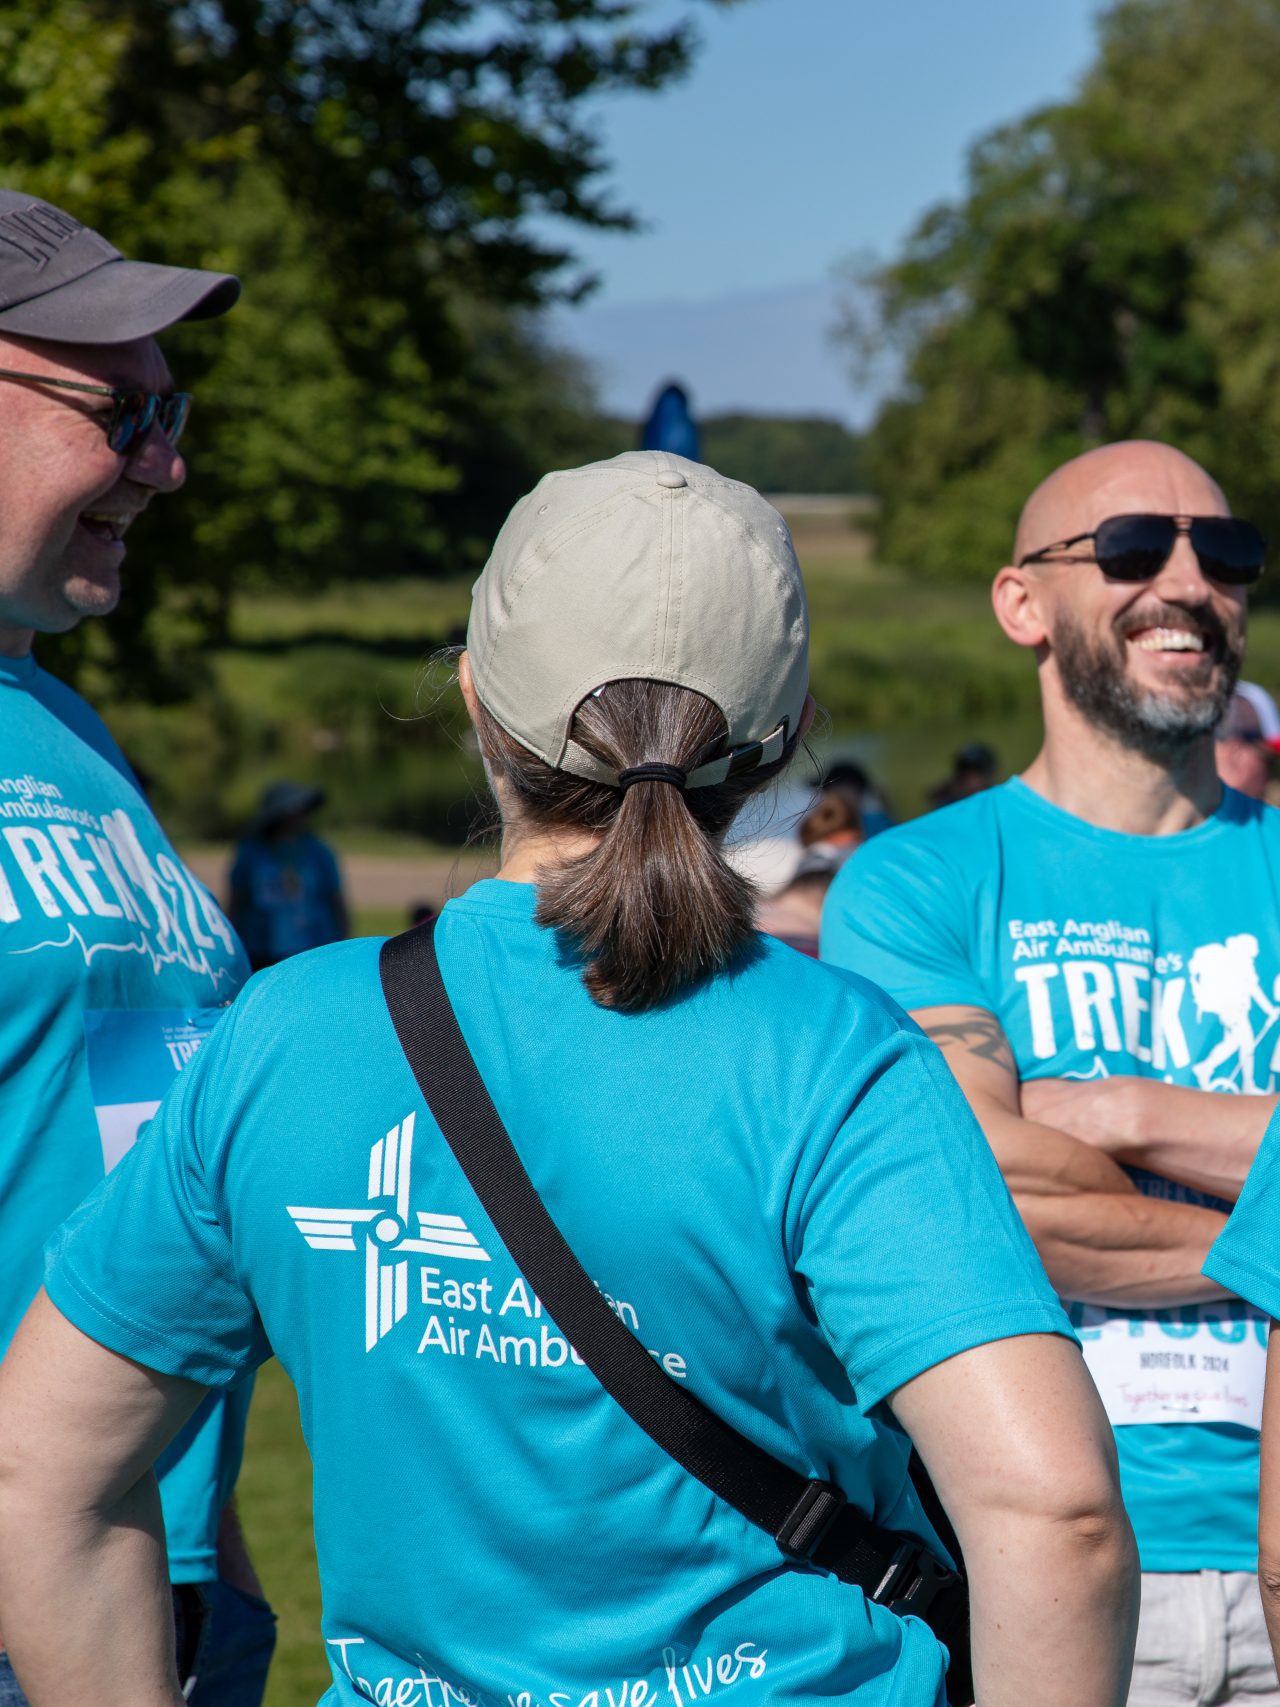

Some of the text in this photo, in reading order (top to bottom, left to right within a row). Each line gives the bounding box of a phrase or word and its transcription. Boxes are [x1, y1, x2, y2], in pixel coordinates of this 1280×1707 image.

[1008, 919, 1150, 945] East Anglian
[1013, 938, 1183, 974] Air Ambulane's
[1014, 960, 1191, 1071] TREK
[420, 1266, 492, 1315] East
[417, 1316, 470, 1355] Air
[662, 1642, 768, 1707] lives
